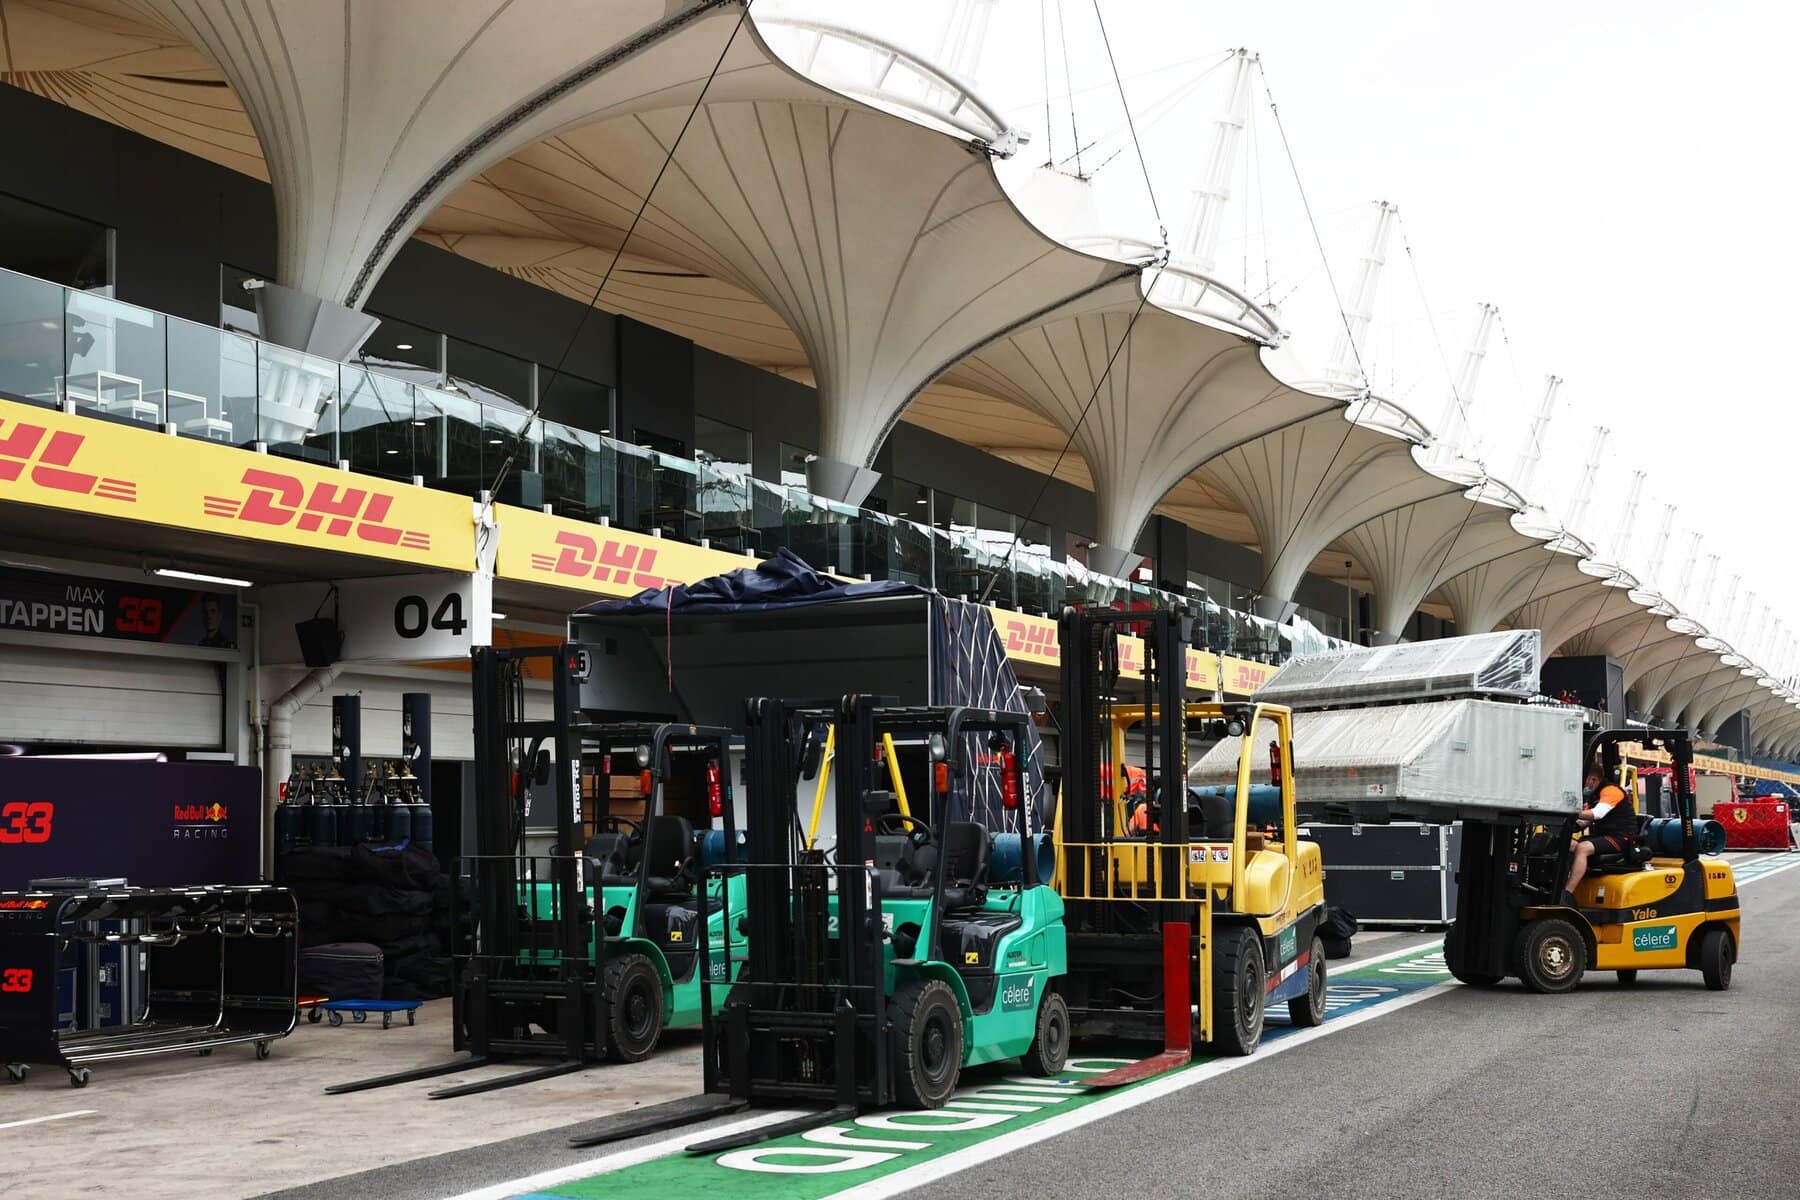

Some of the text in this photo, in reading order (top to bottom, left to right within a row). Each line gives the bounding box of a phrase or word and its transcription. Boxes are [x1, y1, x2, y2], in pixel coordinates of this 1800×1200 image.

[238, 468, 403, 545] DHL
[555, 531, 664, 588] DHL
[66, 585, 105, 604] MAX
[116, 596, 163, 634] 33
[394, 593, 468, 639] 04
[1007, 620, 1058, 657] DHL
[0, 802, 54, 843] 33
[173, 828, 228, 839] RACING
[1632, 907, 1657, 920] Yale
[2, 968, 33, 993] 33
